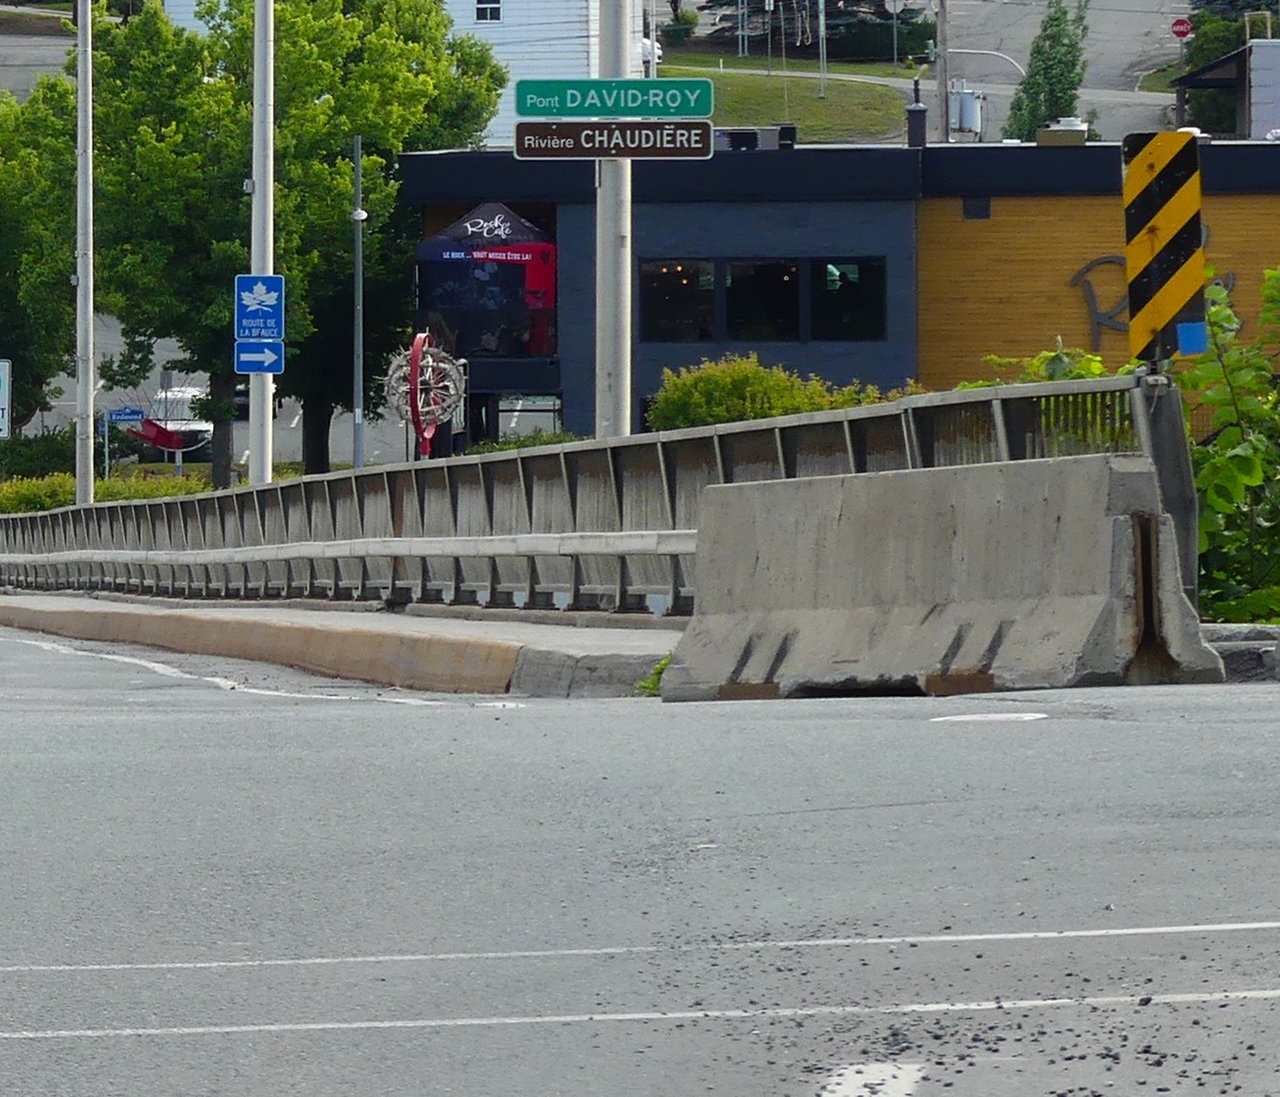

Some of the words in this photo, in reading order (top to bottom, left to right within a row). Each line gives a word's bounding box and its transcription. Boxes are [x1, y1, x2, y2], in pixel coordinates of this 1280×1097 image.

[526, 94, 560, 108] Pont
[566, 89, 701, 108] DAVID-ROY
[524, 135, 575, 149] Rivière
[580, 125, 703, 148] CHAUDIÈRE
[242, 319, 265, 327] ROUTE
[266, 319, 277, 327] DE
[240, 328, 250, 336] LA
[251, 328, 279, 337] BEAUCE
